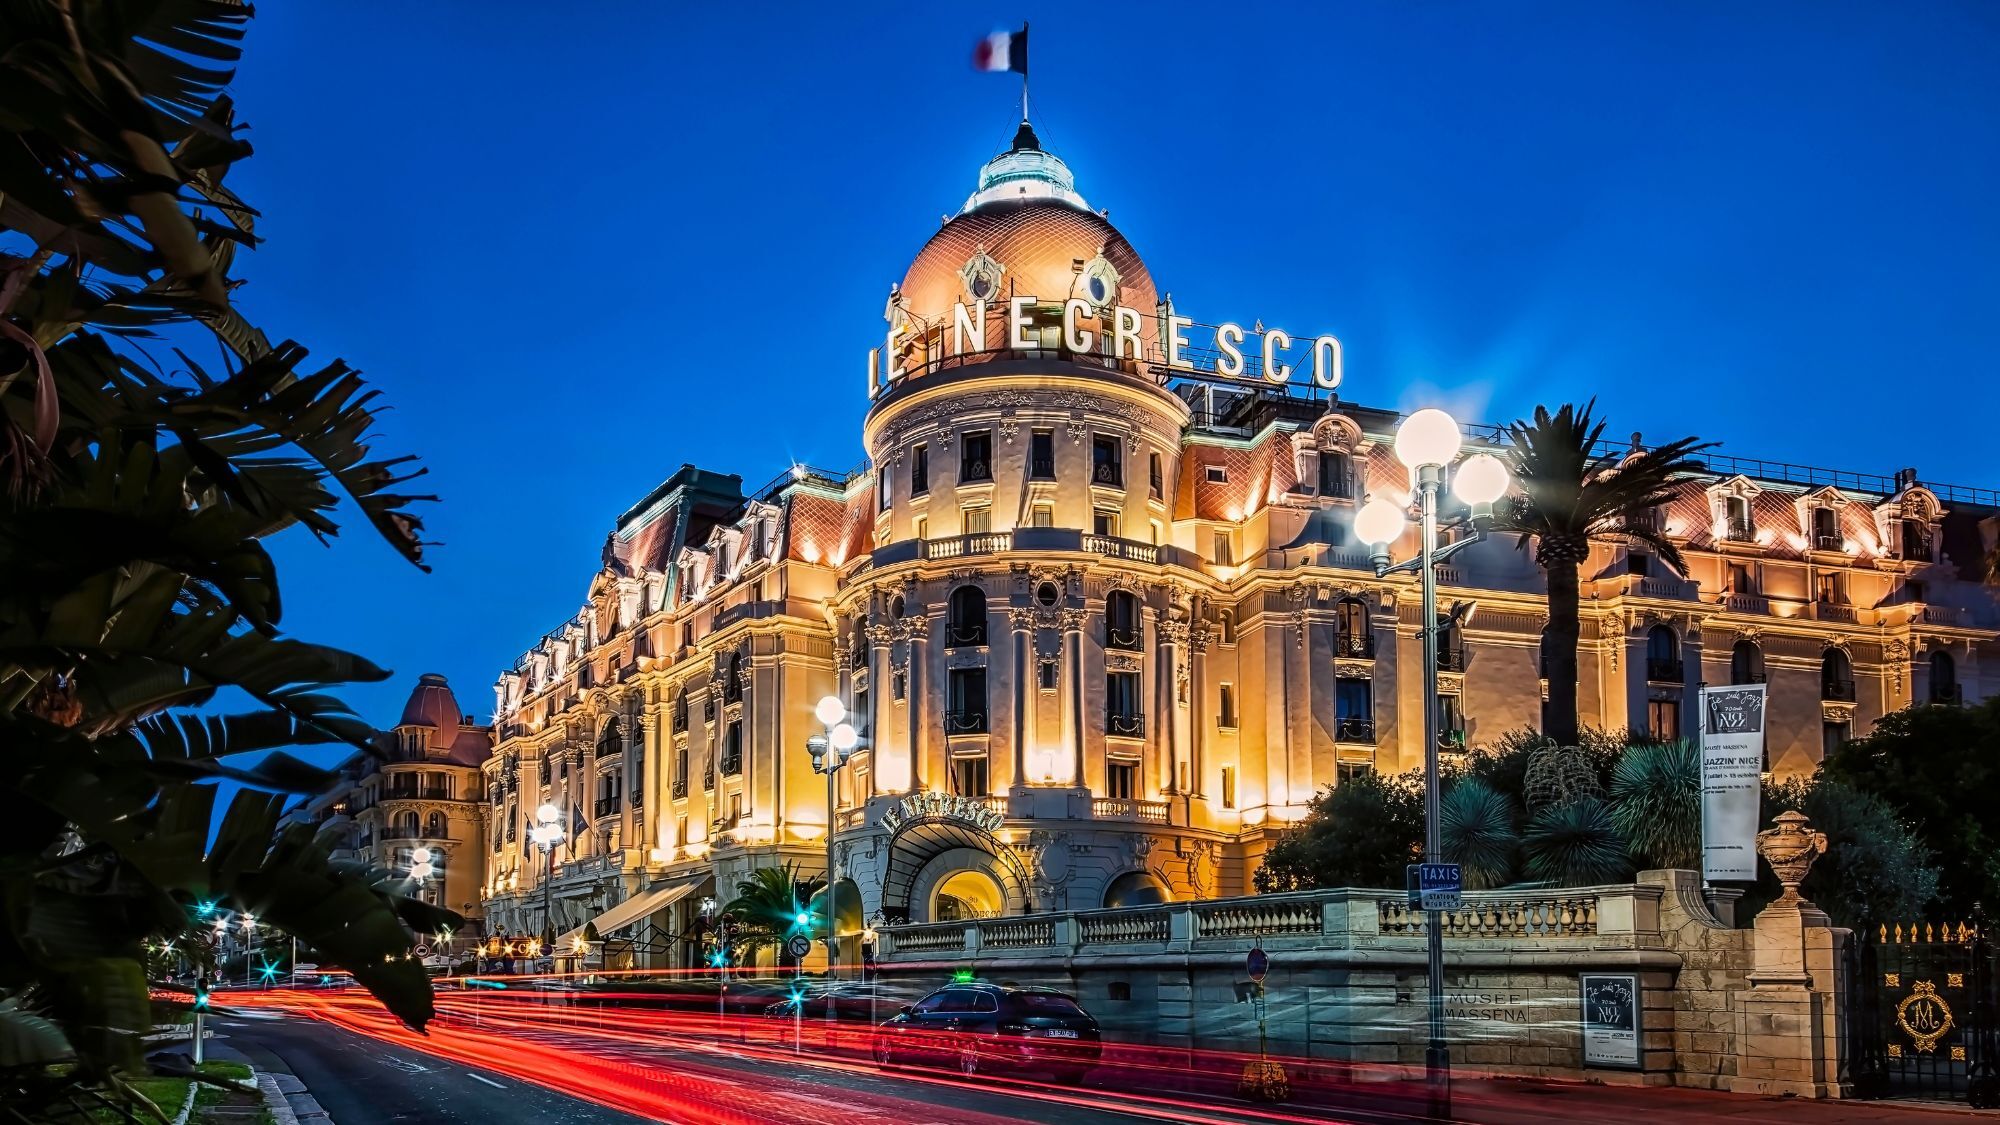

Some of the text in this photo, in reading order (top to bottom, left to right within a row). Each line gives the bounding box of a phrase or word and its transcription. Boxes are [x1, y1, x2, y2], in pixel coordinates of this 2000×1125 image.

[867, 295, 1344, 400] LE NEGRESCO
[1704, 756, 1760, 766] JAZZIN' NICE
[880, 791, 1005, 835] LE NEGRESCO
[1422, 867, 1459, 881] TAXIS
[1449, 991, 1521, 1005] MUSÉE
